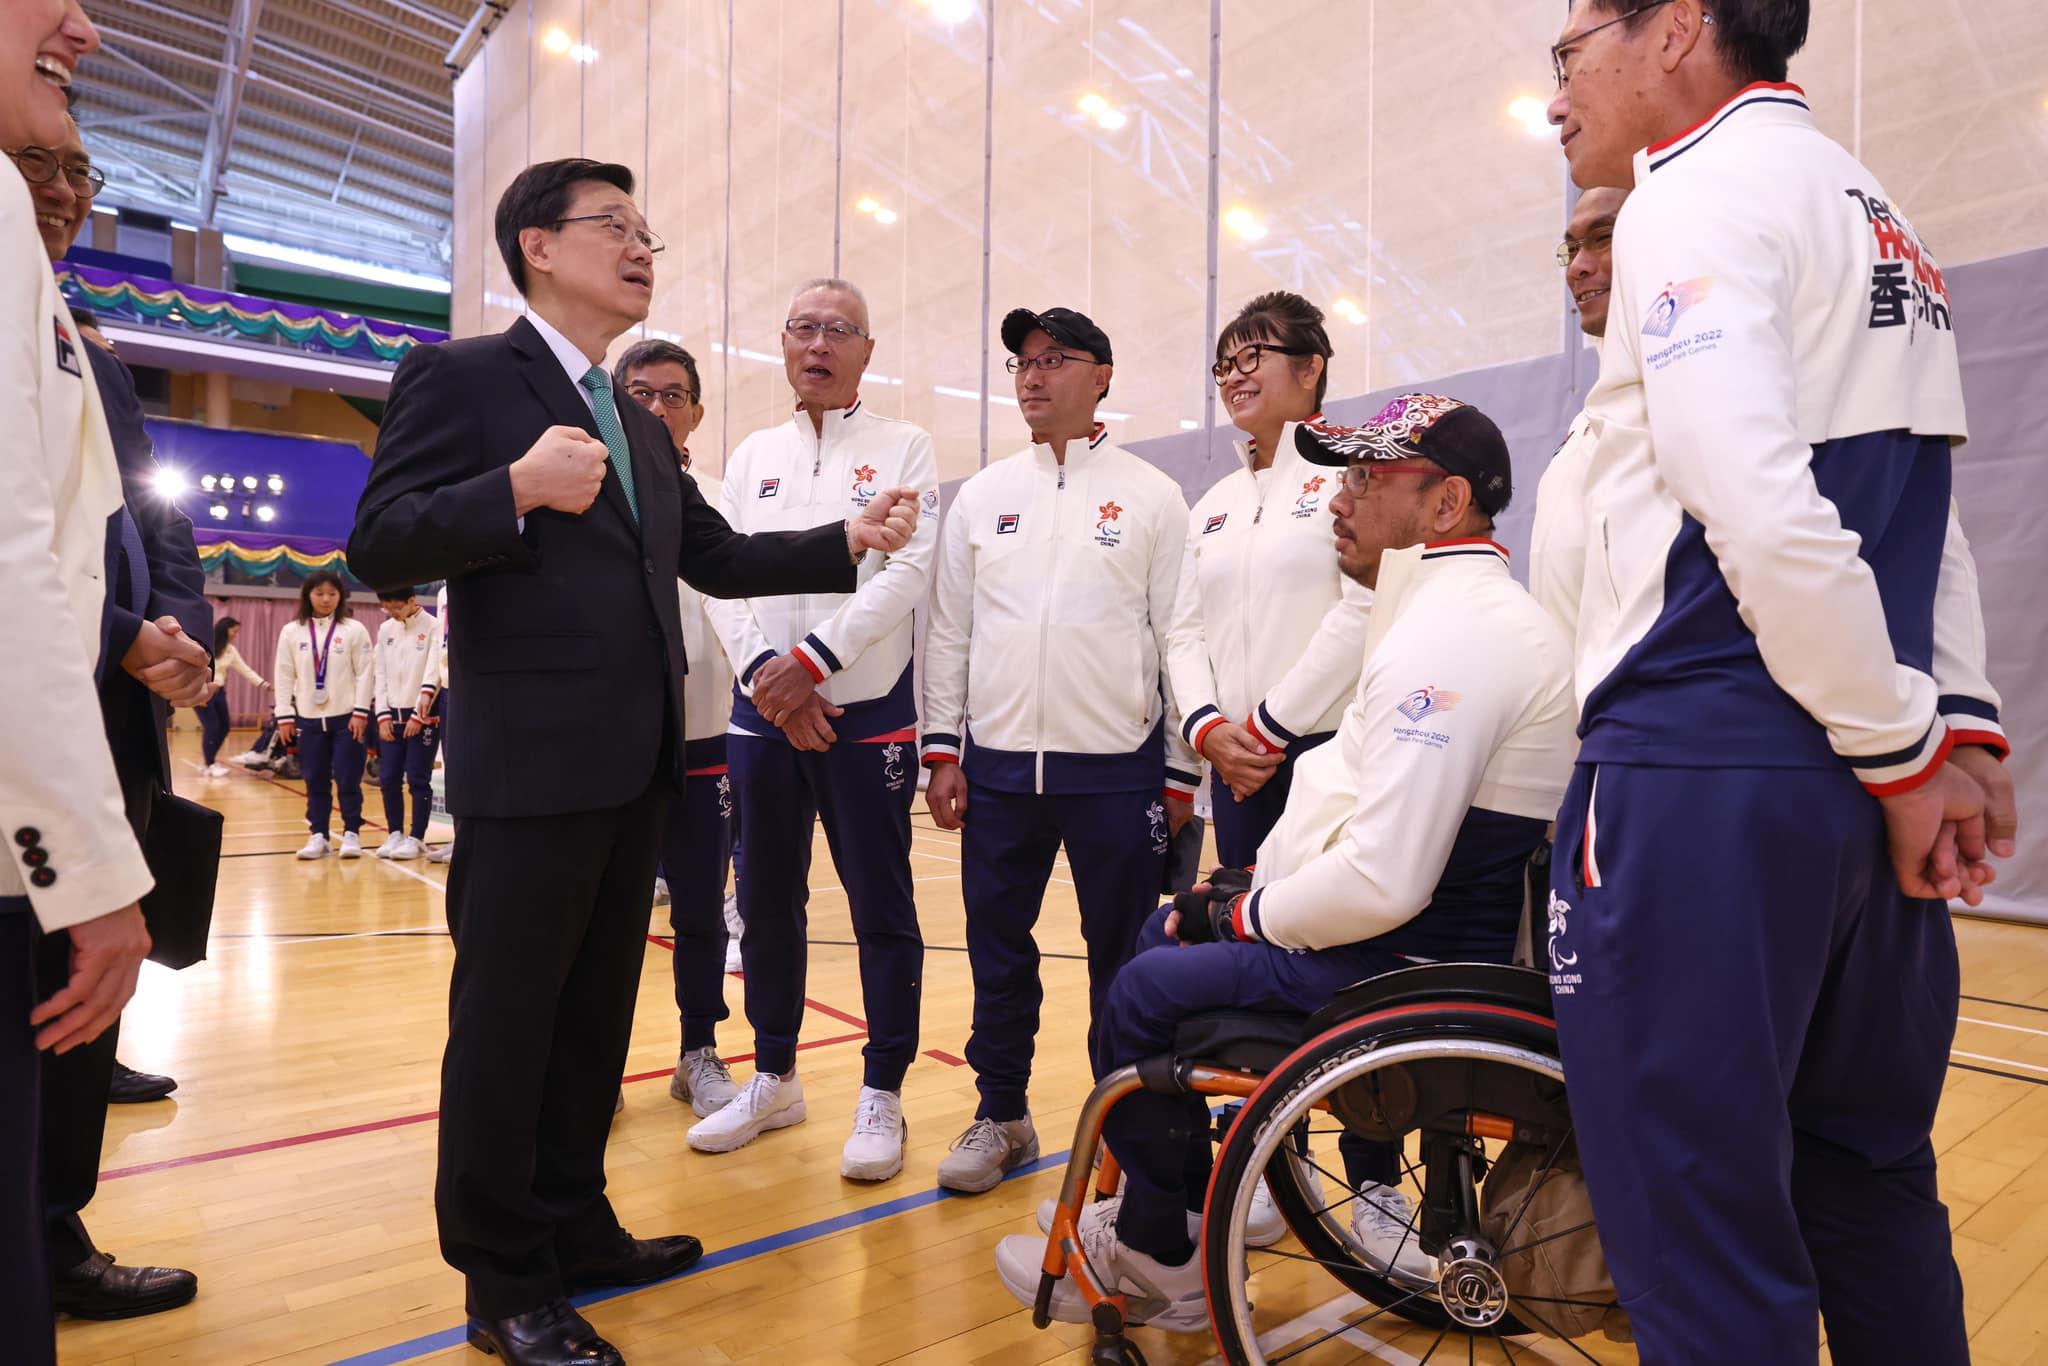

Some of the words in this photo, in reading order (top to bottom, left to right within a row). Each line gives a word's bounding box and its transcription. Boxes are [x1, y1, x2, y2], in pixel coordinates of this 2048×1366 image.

[1646, 338, 1691, 365] Hangzhou
[1694, 329, 1723, 344] 2022
[1393, 727, 1430, 738] Hangzhou
[1430, 731, 1450, 744] 2022
[1562, 974, 1582, 984] KONG
[1554, 984, 1576, 995] CHINA
